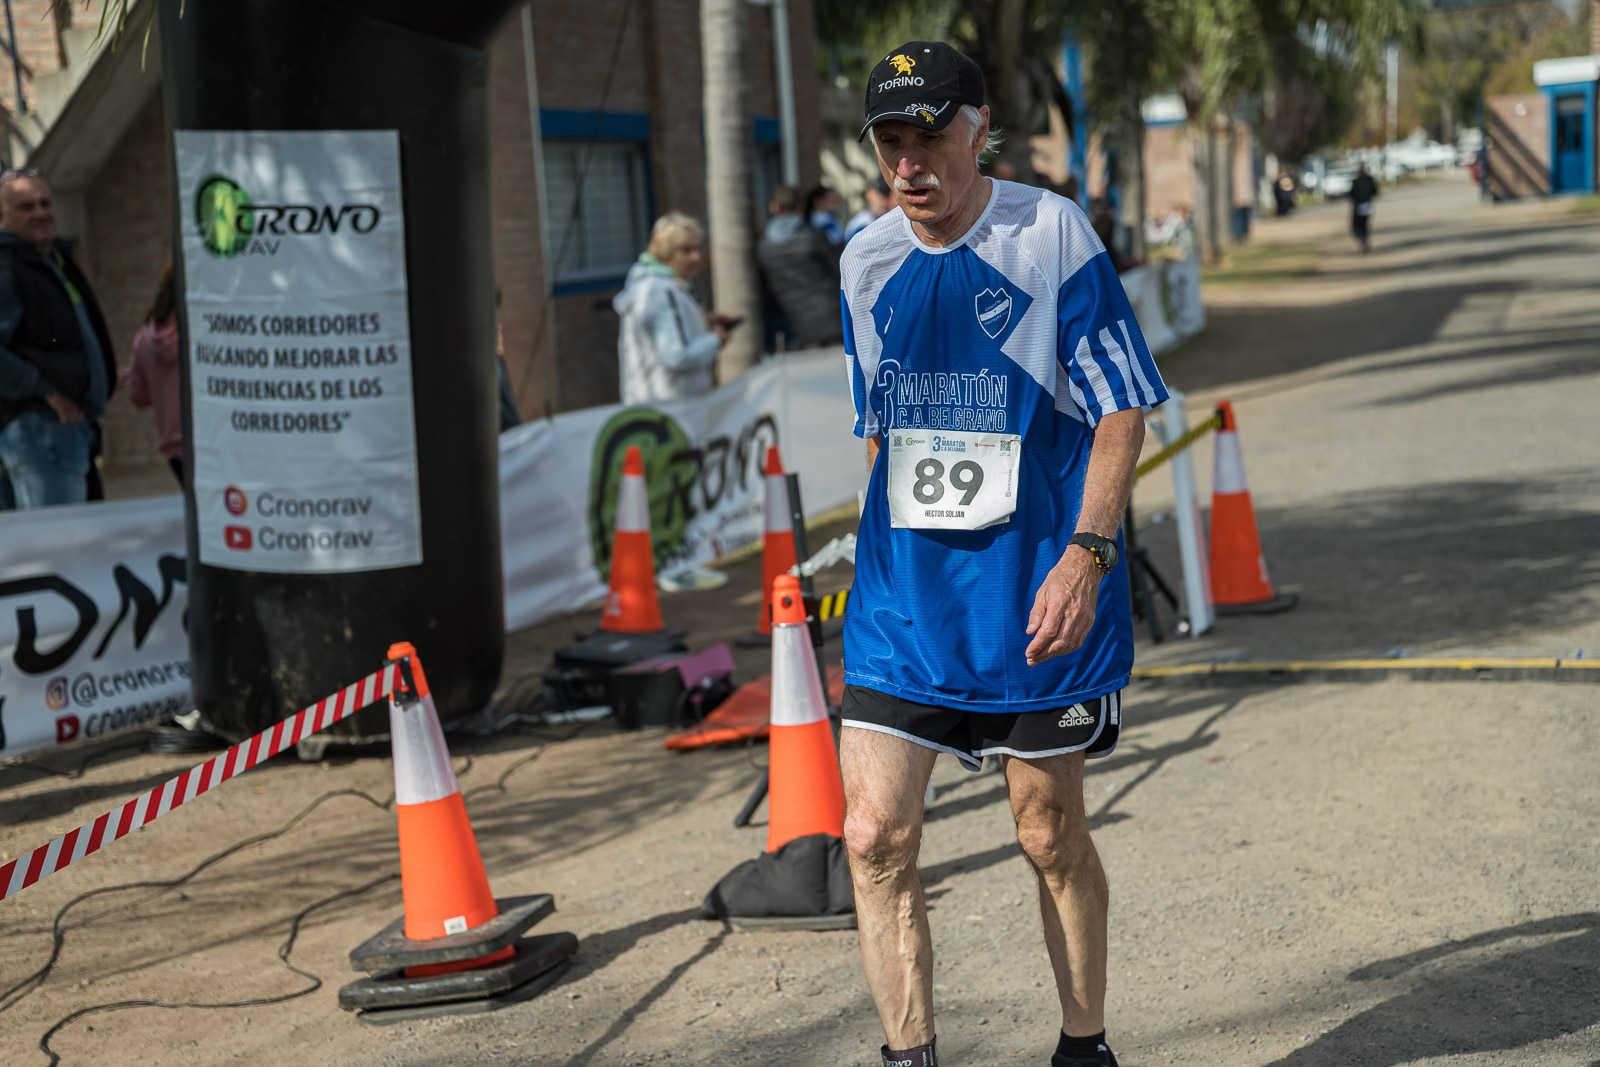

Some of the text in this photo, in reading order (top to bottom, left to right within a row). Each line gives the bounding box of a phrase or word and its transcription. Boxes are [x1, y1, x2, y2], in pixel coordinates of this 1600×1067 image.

[878, 76, 925, 93] TORINO
[905, 103, 937, 113] TORINO
[261, 313, 380, 336] CORREDORES
[196, 343, 398, 369] BUSCANDO MEJORAR LAS
[207, 376, 383, 400] EXPERIENCIAS DE LOS
[897, 369, 1007, 407] MARATÓN
[913, 458, 984, 506] 89
[256, 492, 372, 518] Cronorav
[924, 509, 965, 518] HECTOR SOLJAN
[258, 525, 374, 551] Cronorav
[1058, 716, 1095, 728] adidas
